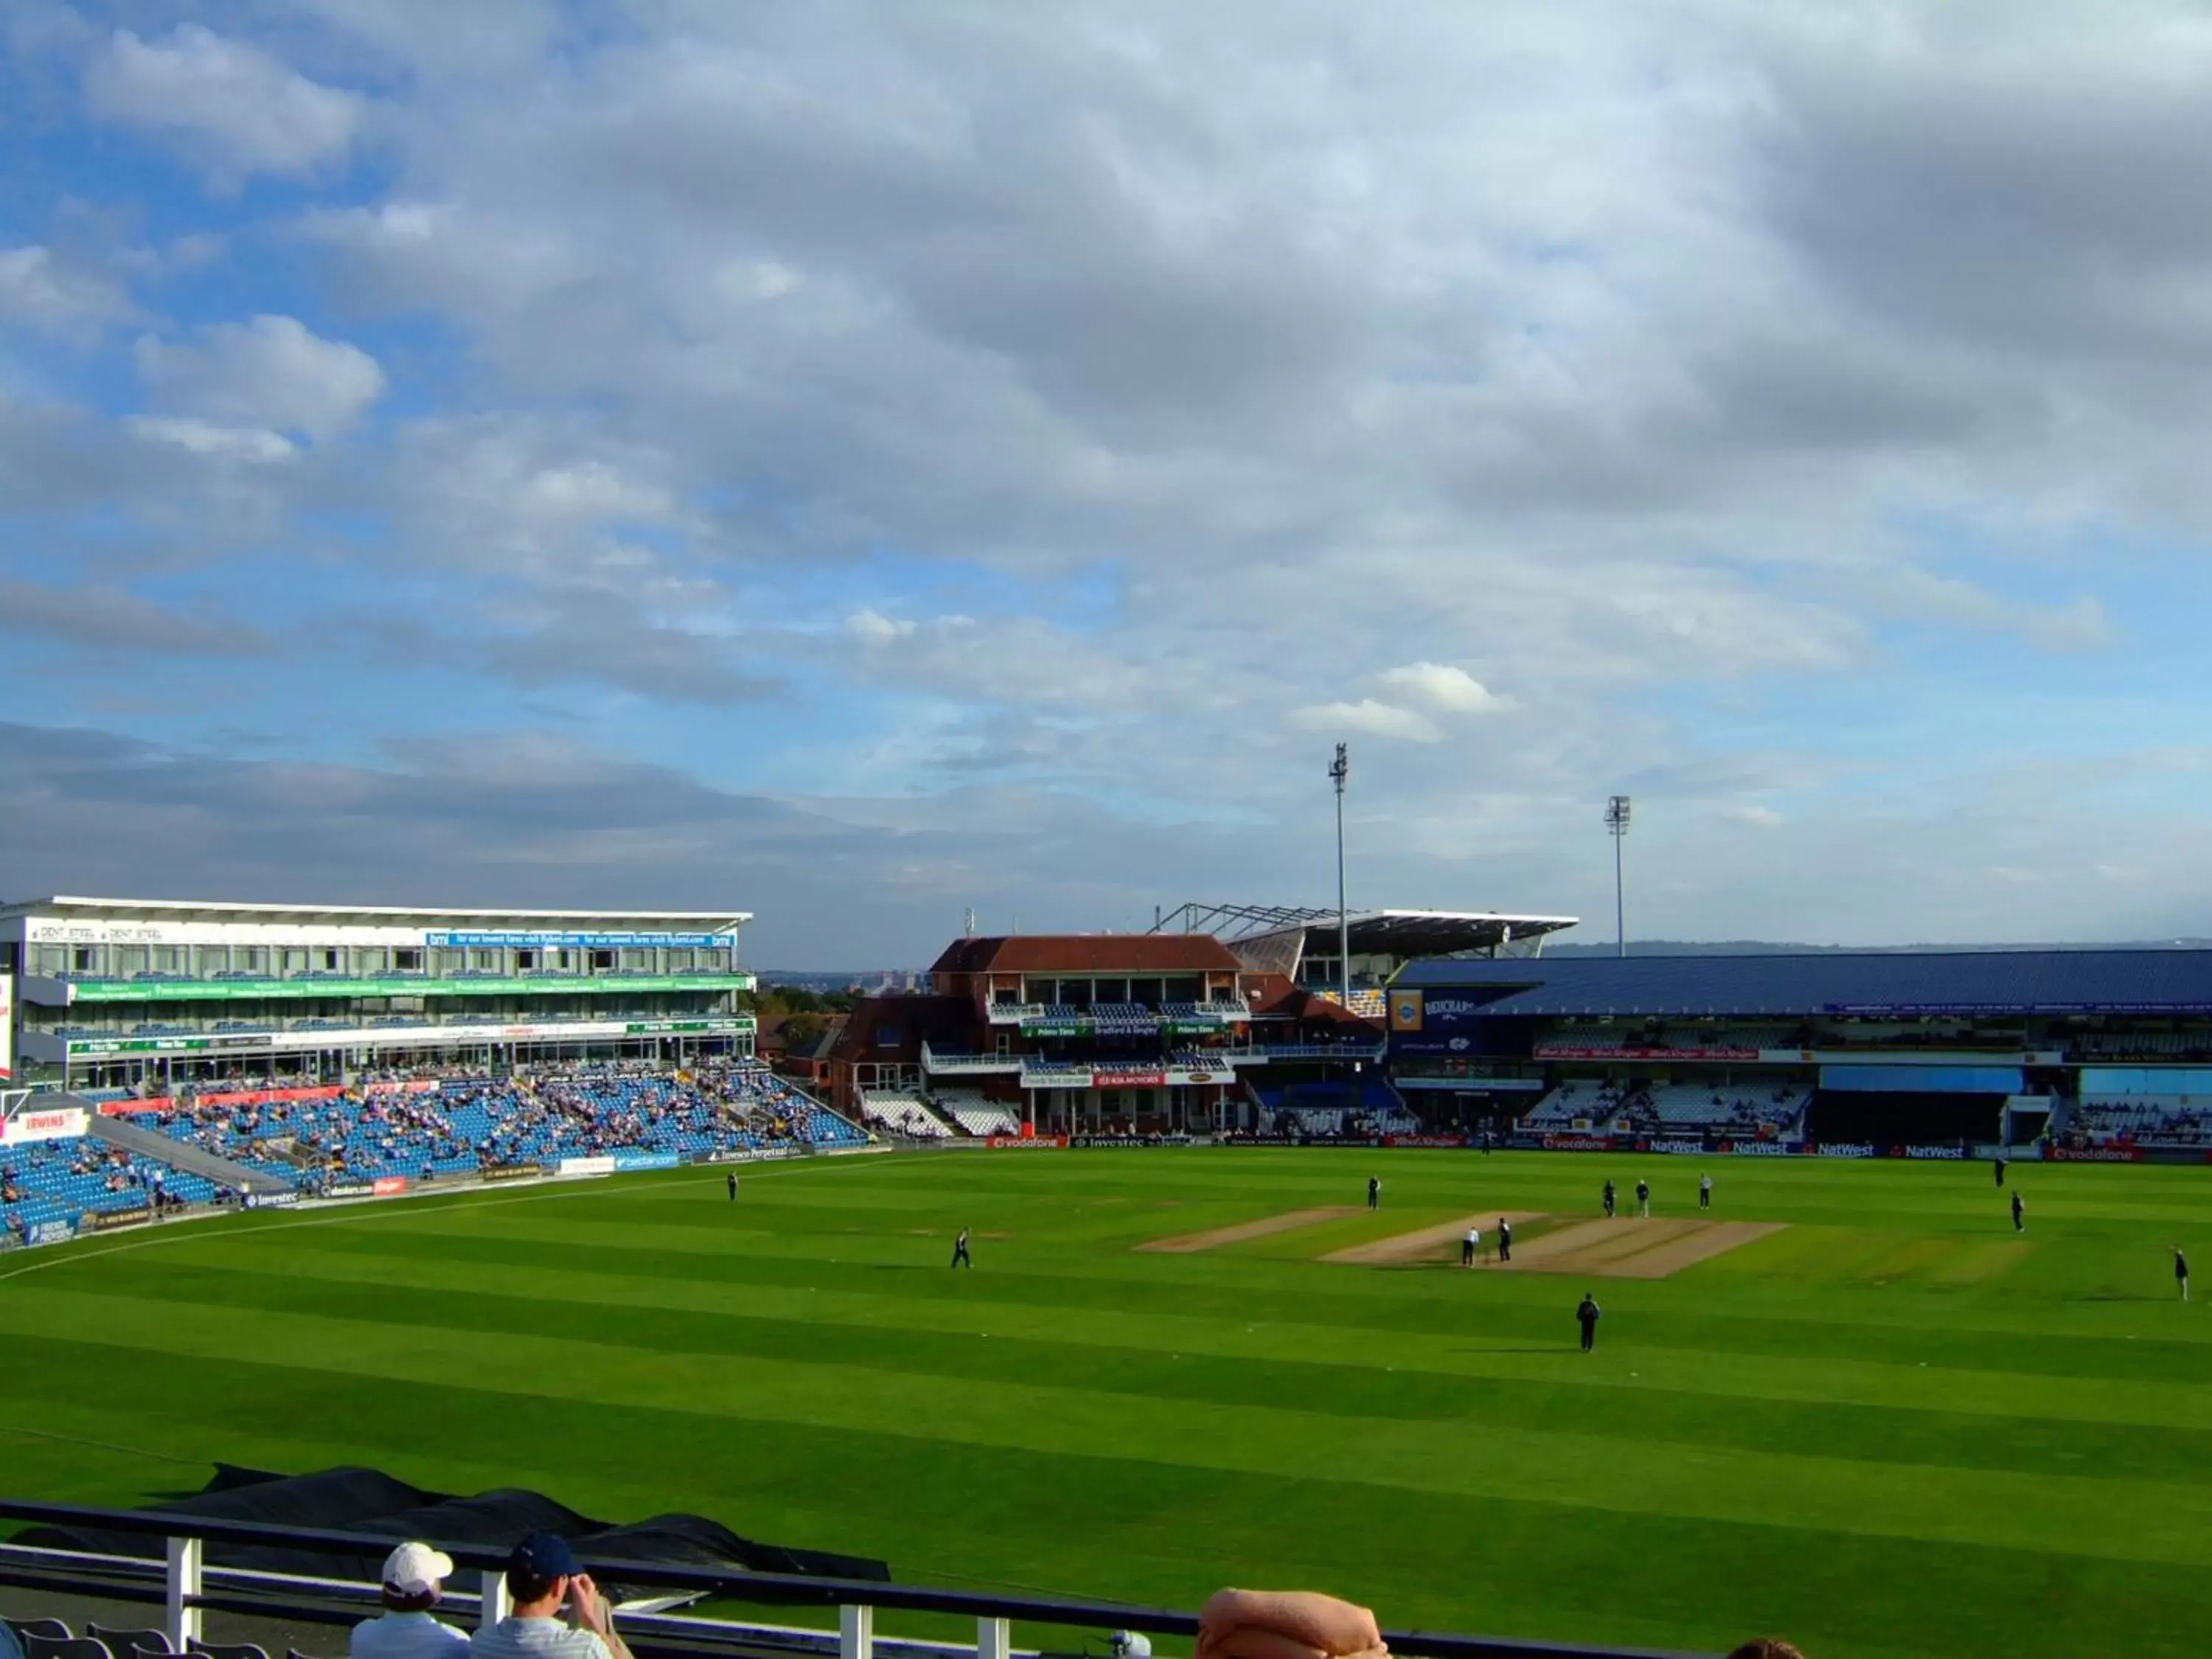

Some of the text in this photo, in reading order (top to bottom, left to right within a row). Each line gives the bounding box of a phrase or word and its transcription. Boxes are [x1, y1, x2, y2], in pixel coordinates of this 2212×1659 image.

[26, 1116, 64, 1130] IRWINS
[1004, 1135, 1058, 1148] vodafone
[1650, 1140, 1703, 1152] NatWest
[1733, 1141, 1787, 1155] NatWest
[1818, 1142, 1875, 1157] NatWest
[1905, 1145, 1964, 1158] NatWest
[2068, 1147, 2133, 1160] vodafone
